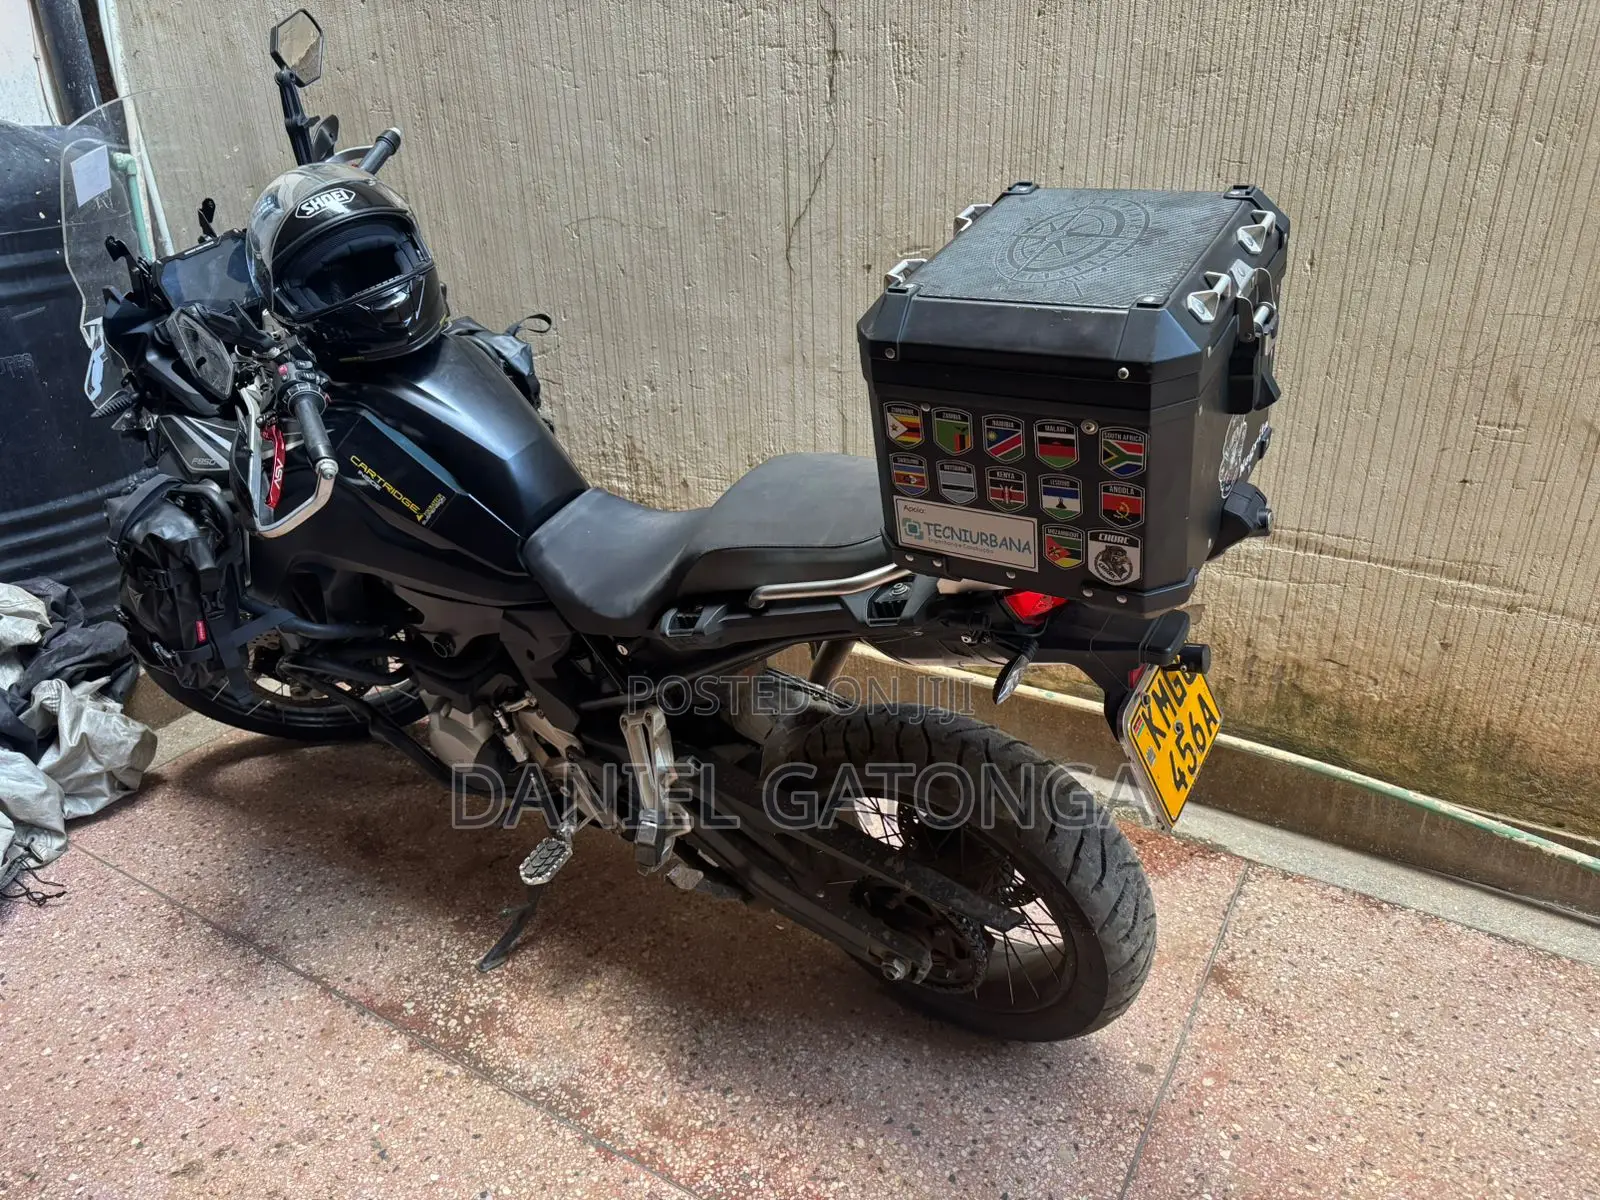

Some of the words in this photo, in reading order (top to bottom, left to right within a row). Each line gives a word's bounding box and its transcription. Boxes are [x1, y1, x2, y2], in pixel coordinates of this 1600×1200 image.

[300, 189, 350, 216] SHOEI
[1045, 425, 1067, 433] MALAWI
[274, 458, 285, 490] ASV
[350, 455, 420, 514] CARTRIDGE
[996, 471, 1015, 480] KENYA
[1109, 485, 1135, 496] ANGOLA
[923, 521, 1032, 555] TECNIURBANA
[1169, 694, 1218, 793] 456A
